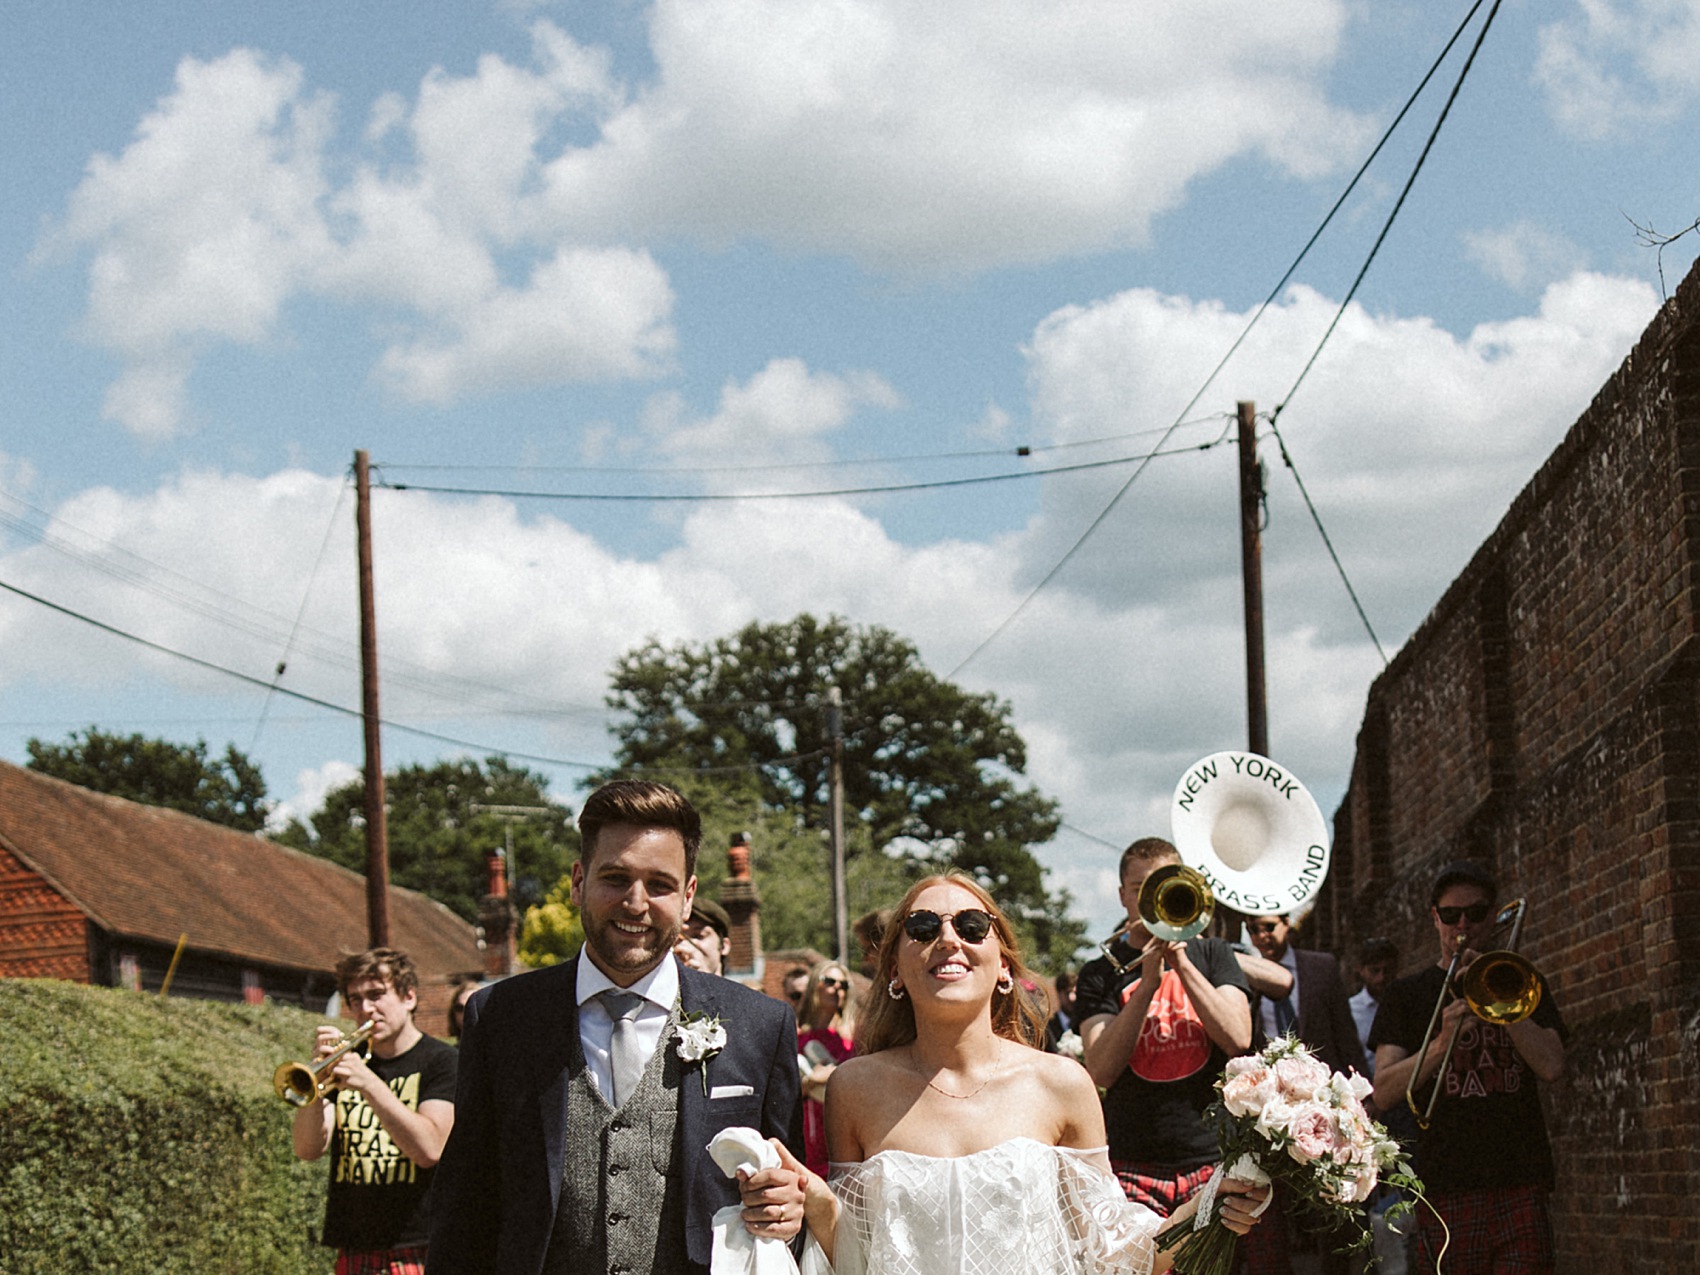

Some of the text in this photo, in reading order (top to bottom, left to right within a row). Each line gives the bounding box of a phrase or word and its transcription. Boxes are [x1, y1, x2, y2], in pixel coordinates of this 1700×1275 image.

[1178, 756, 1299, 812] NEW YORK
[1288, 844, 1325, 901] BAND
[1445, 1069, 1521, 1098] BAND
